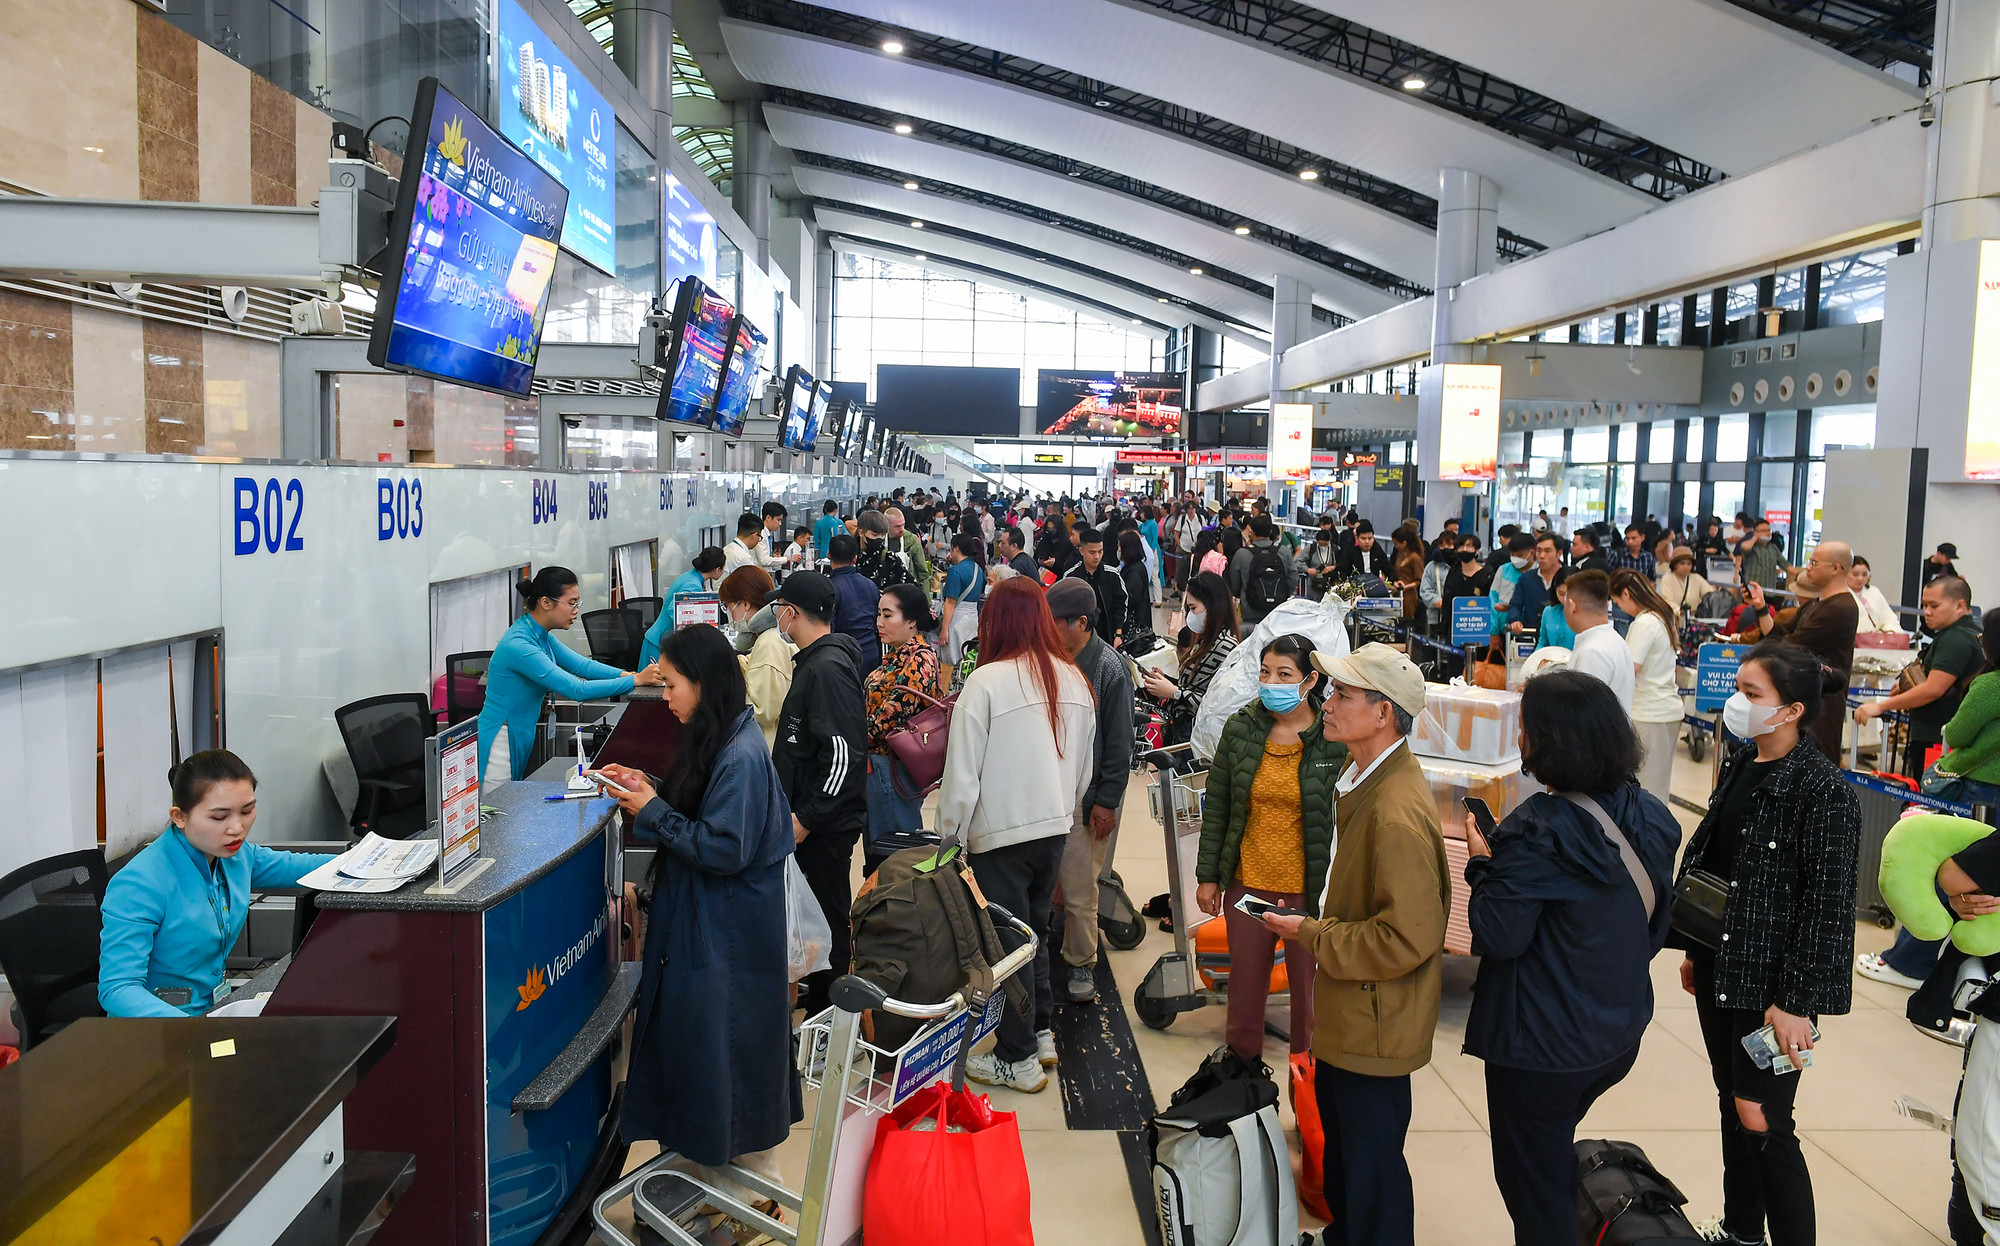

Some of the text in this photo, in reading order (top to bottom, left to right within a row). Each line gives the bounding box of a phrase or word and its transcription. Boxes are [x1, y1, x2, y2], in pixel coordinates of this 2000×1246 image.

[466, 140, 512, 199] Vietnam
[510, 177, 547, 226] Airlines
[435, 260, 485, 312] Baggage
[378, 477, 423, 541] B03
[533, 478, 558, 525] B04
[589, 480, 608, 521] B05
[660, 478, 674, 510] B06
[687, 478, 698, 508] B07
[234, 477, 304, 556] B02
[1702, 679, 1720, 687] CHỜ
[1707, 671, 1736, 680] VUI LÒN
[1856, 776, 1869, 785] N.I.A
[1884, 785, 1904, 797] NOIBAI
[1904, 791, 1949, 810] INTERNATIONAL
[546, 930, 592, 986] Vietnam
[937, 1022, 960, 1049] 20.000
[904, 1043, 930, 1068] BIZMAN
